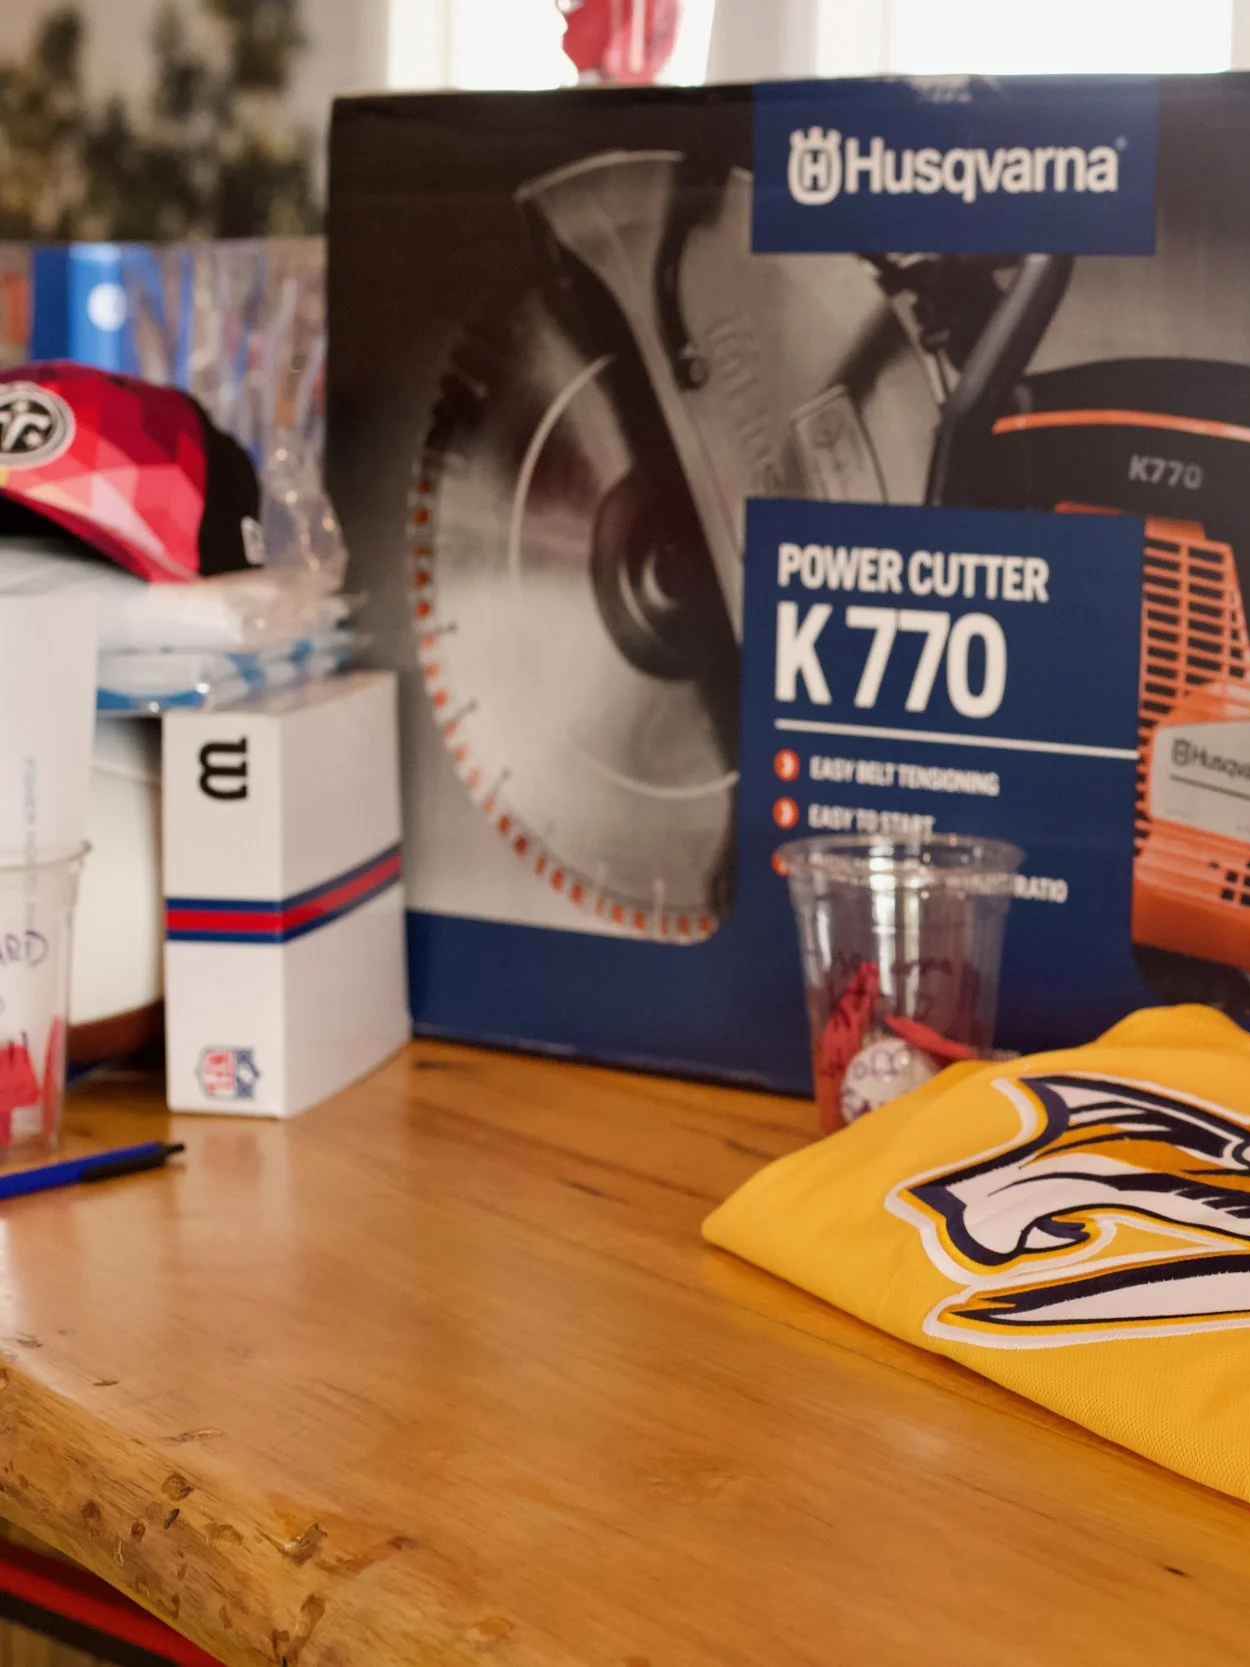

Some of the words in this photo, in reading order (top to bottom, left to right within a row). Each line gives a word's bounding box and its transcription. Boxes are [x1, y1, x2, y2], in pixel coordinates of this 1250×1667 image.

[844, 137, 1119, 202] Husqvarna
[1128, 455, 1203, 490] K770
[777, 543, 903, 594] POWER
[907, 551, 1050, 603] CUTTER
[774, 601, 833, 705] K
[845, 606, 1008, 719] 770
[809, 755, 854, 783] EASY
[856, 757, 895, 787] BELT
[897, 760, 1000, 797] TENSIONING
[808, 803, 854, 832] EASY
[856, 807, 879, 834] TO
[1012, 874, 1069, 904] RATIO
